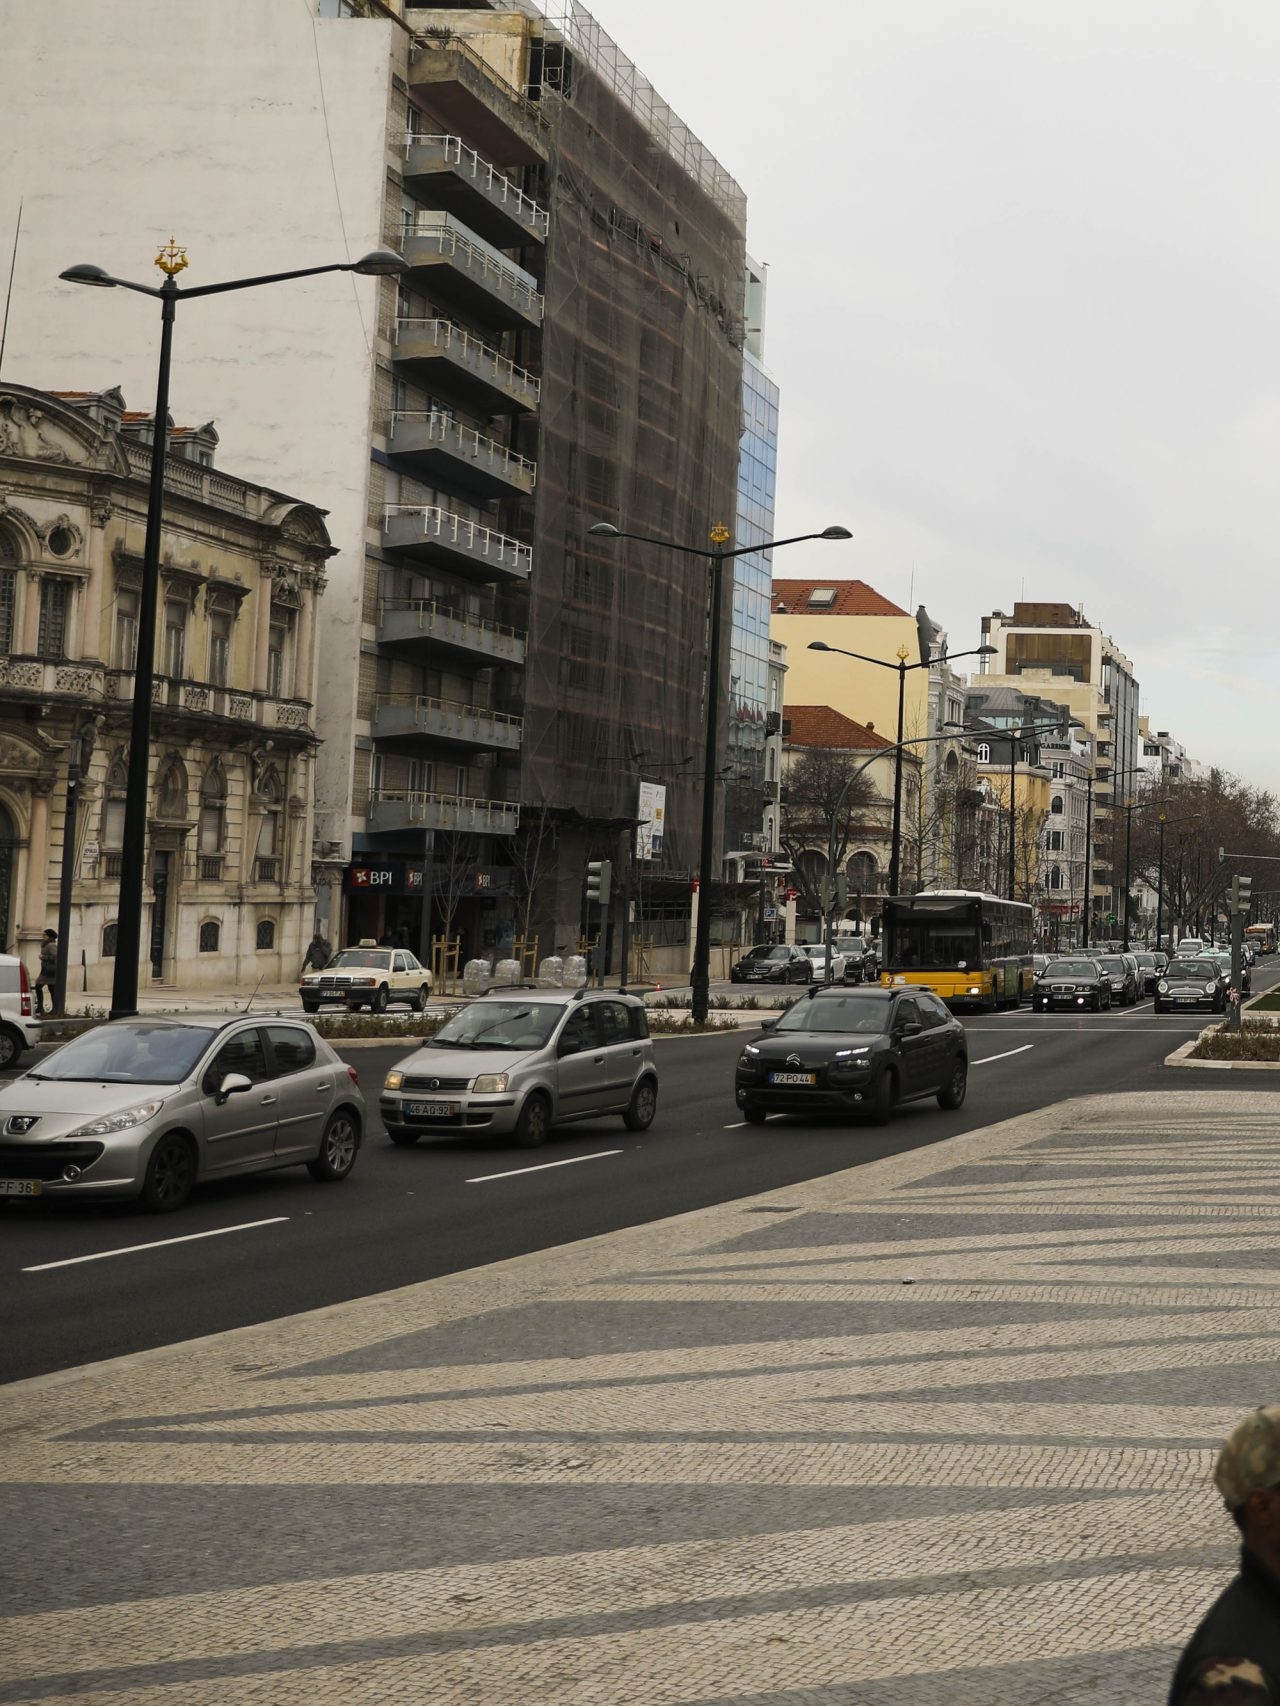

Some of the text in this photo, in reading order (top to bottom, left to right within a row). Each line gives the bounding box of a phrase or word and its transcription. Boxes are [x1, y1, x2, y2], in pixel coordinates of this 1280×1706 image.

[370, 871, 392, 885] BPI
[413, 872, 423, 886] BPI
[482, 874, 491, 887] BPI
